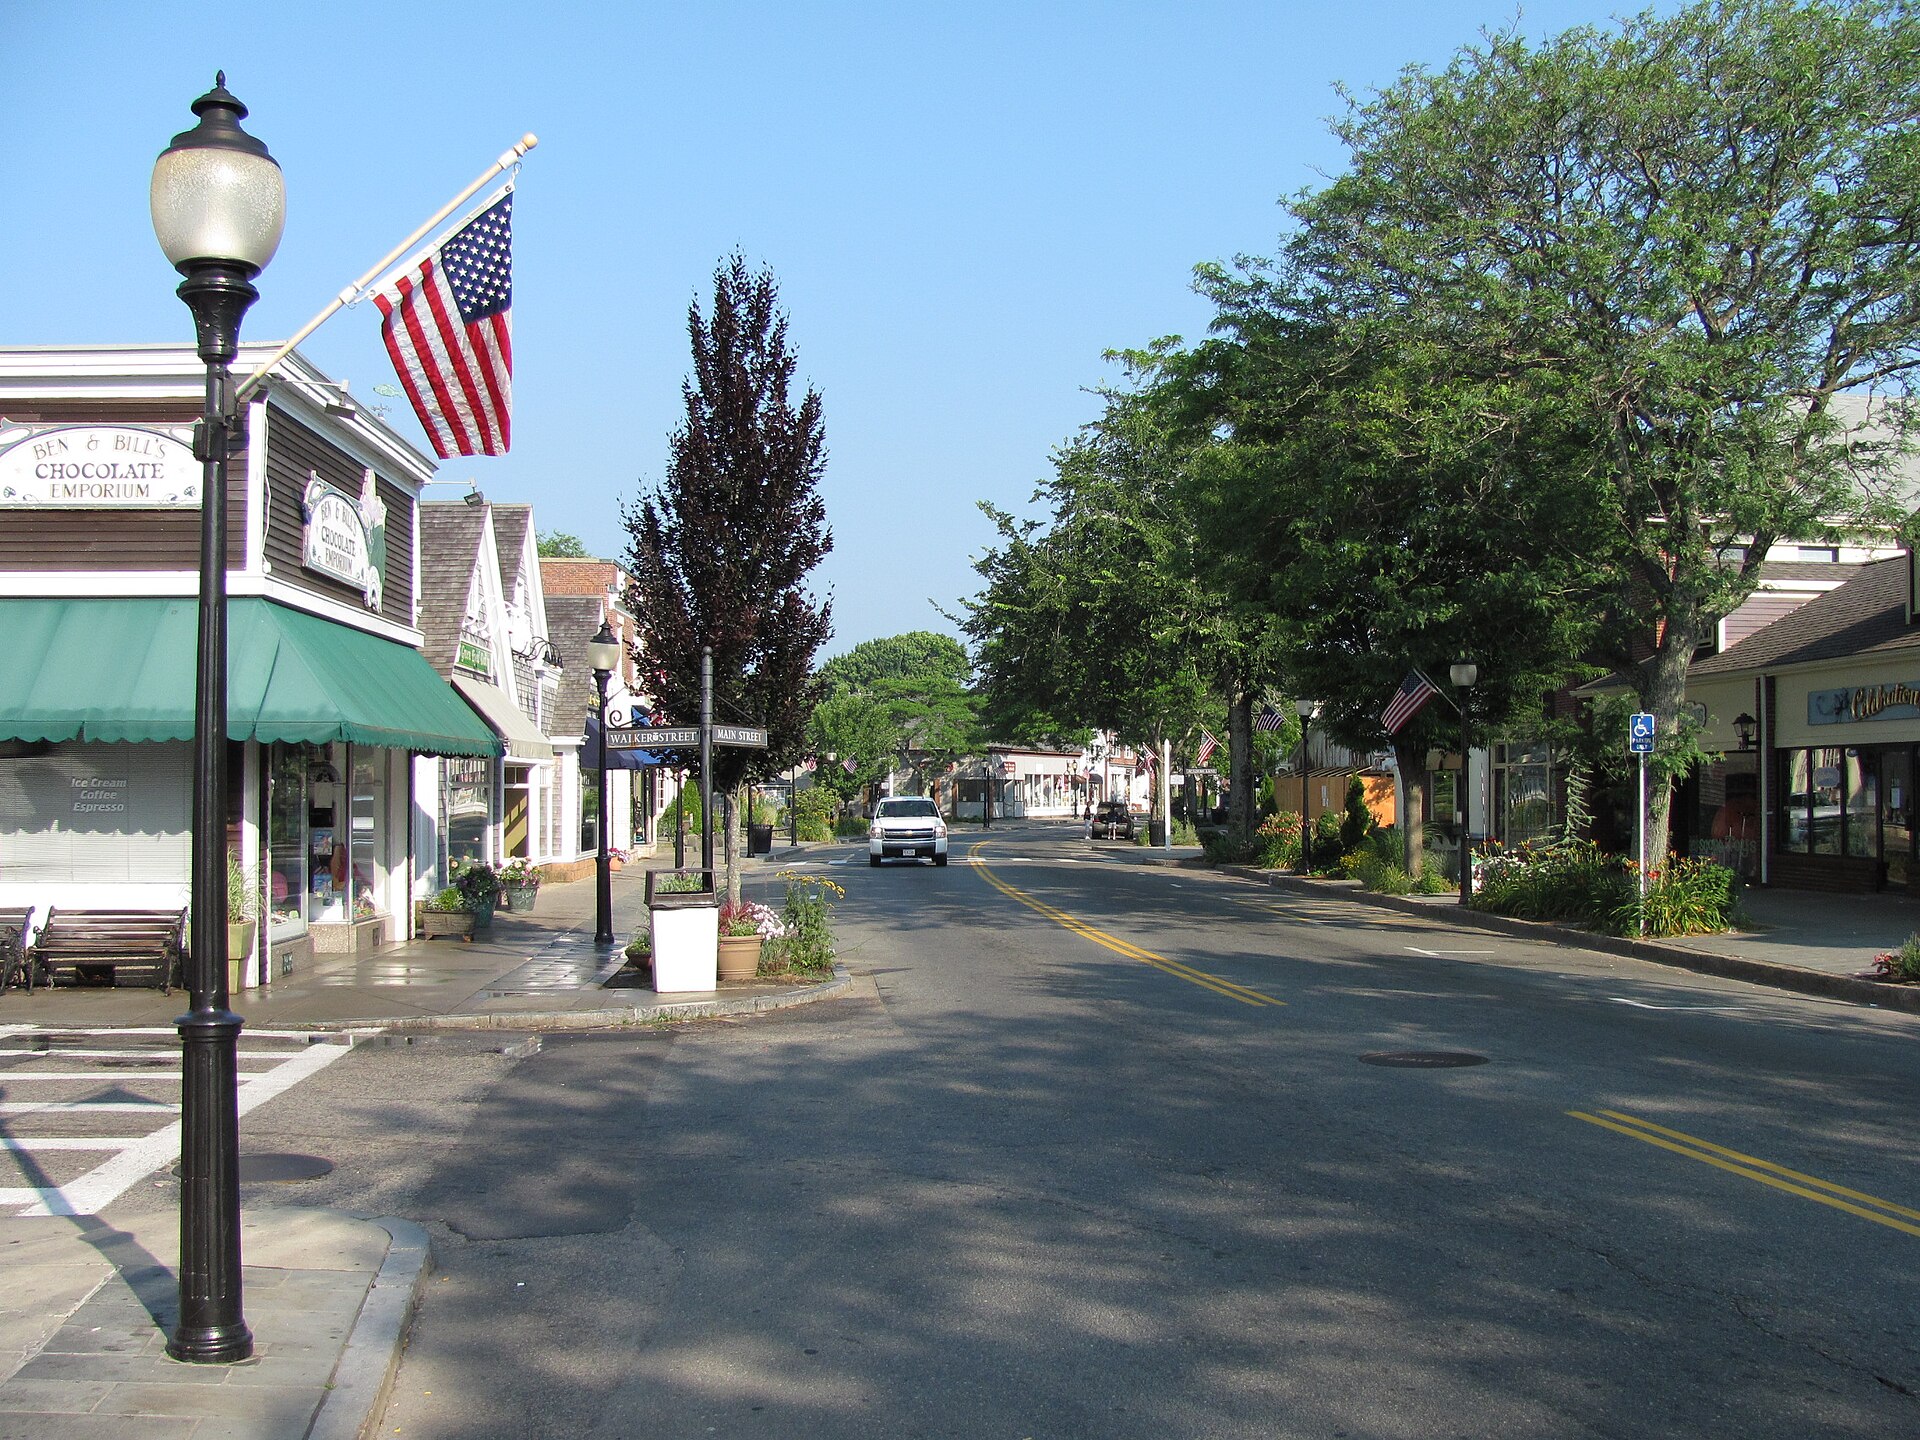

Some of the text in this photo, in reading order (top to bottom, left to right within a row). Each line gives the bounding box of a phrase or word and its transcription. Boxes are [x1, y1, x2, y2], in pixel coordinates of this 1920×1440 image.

[33, 434, 168, 460] BEN & BILL'S
[35, 462, 164, 480] CHOCOLATE
[51, 483, 150, 499] EMPORIUM
[322, 525, 356, 557] CHOCOLATE
[610, 731, 697, 744] WALKER STREET
[717, 728, 762, 742] MAIN STREET
[71, 778, 127, 788] Ice Cream
[80, 789, 118, 800] Coffee
[73, 802, 125, 813] Espresso
